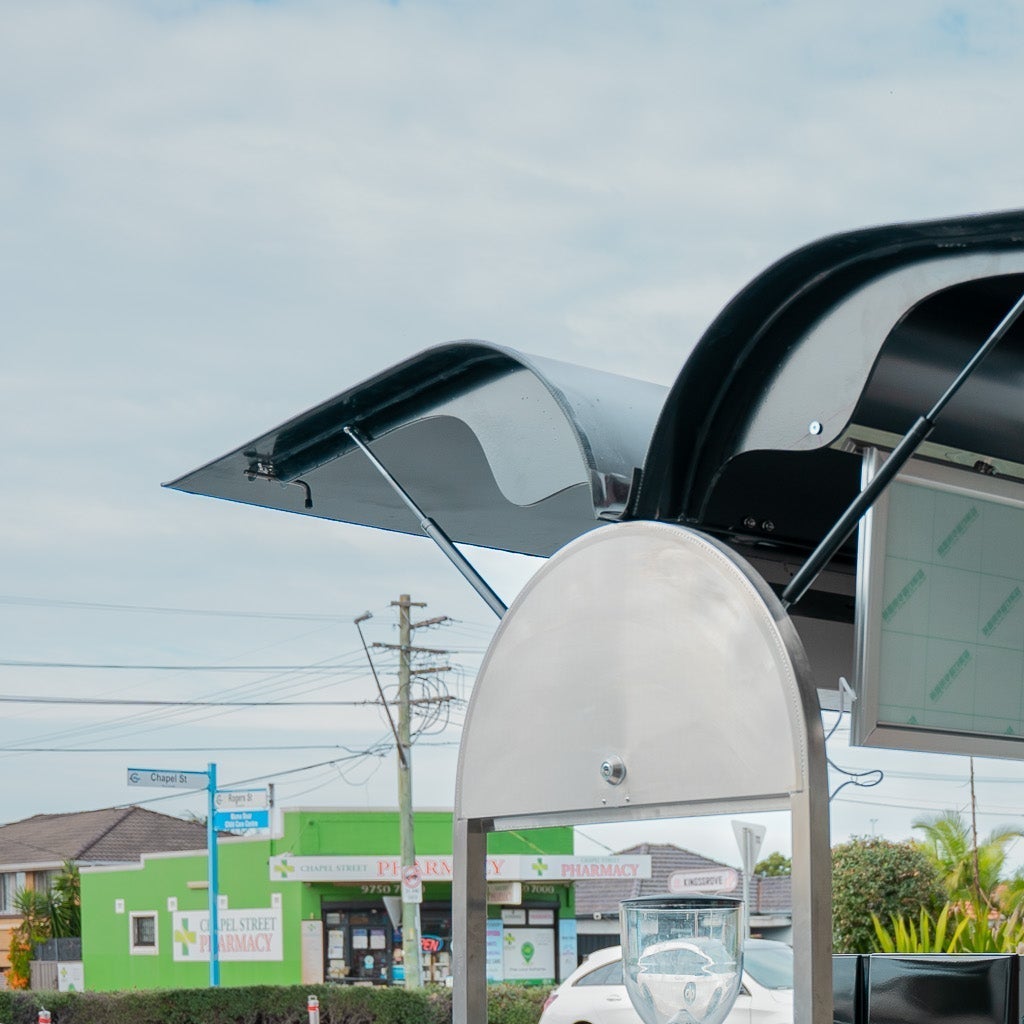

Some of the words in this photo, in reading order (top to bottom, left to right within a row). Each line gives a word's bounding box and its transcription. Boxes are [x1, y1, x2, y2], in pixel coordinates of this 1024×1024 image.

[150, 772, 177, 786] Chapel
[180, 774, 188, 784] St
[228, 794, 246, 804] Rogers
[336, 864, 368, 872] STREET
[561, 863, 639, 877] PHARMACY
[361, 885, 390, 894] 9750
[532, 885, 554, 894] 7000
[200, 918, 238, 932] CPEL
[240, 917, 277, 931] STREET
[420, 938, 439, 952] PEN
